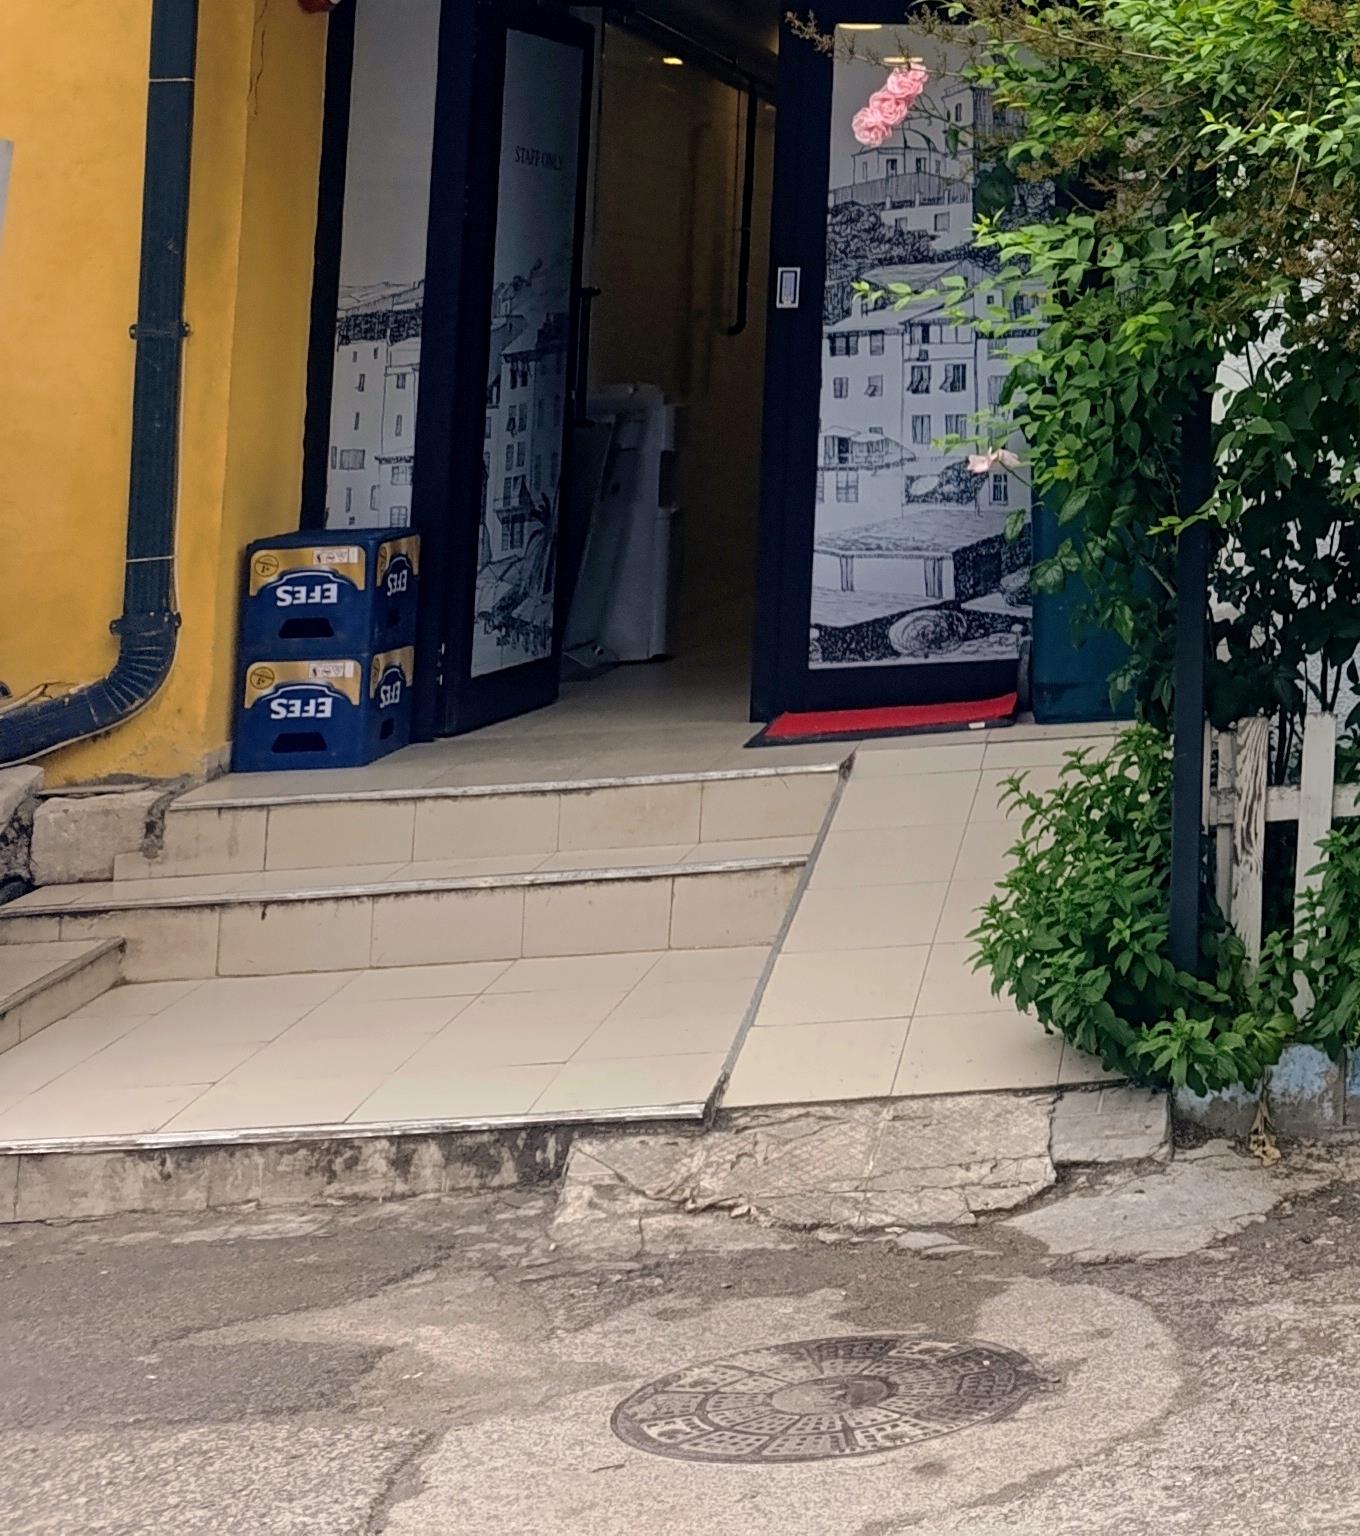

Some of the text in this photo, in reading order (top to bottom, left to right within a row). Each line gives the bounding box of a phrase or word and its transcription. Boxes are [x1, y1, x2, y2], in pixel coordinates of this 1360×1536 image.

[276, 583, 338, 607] EFES
[387, 569, 408, 596] EFES
[380, 681, 401, 708] EFES
[270, 697, 333, 720] EFES
